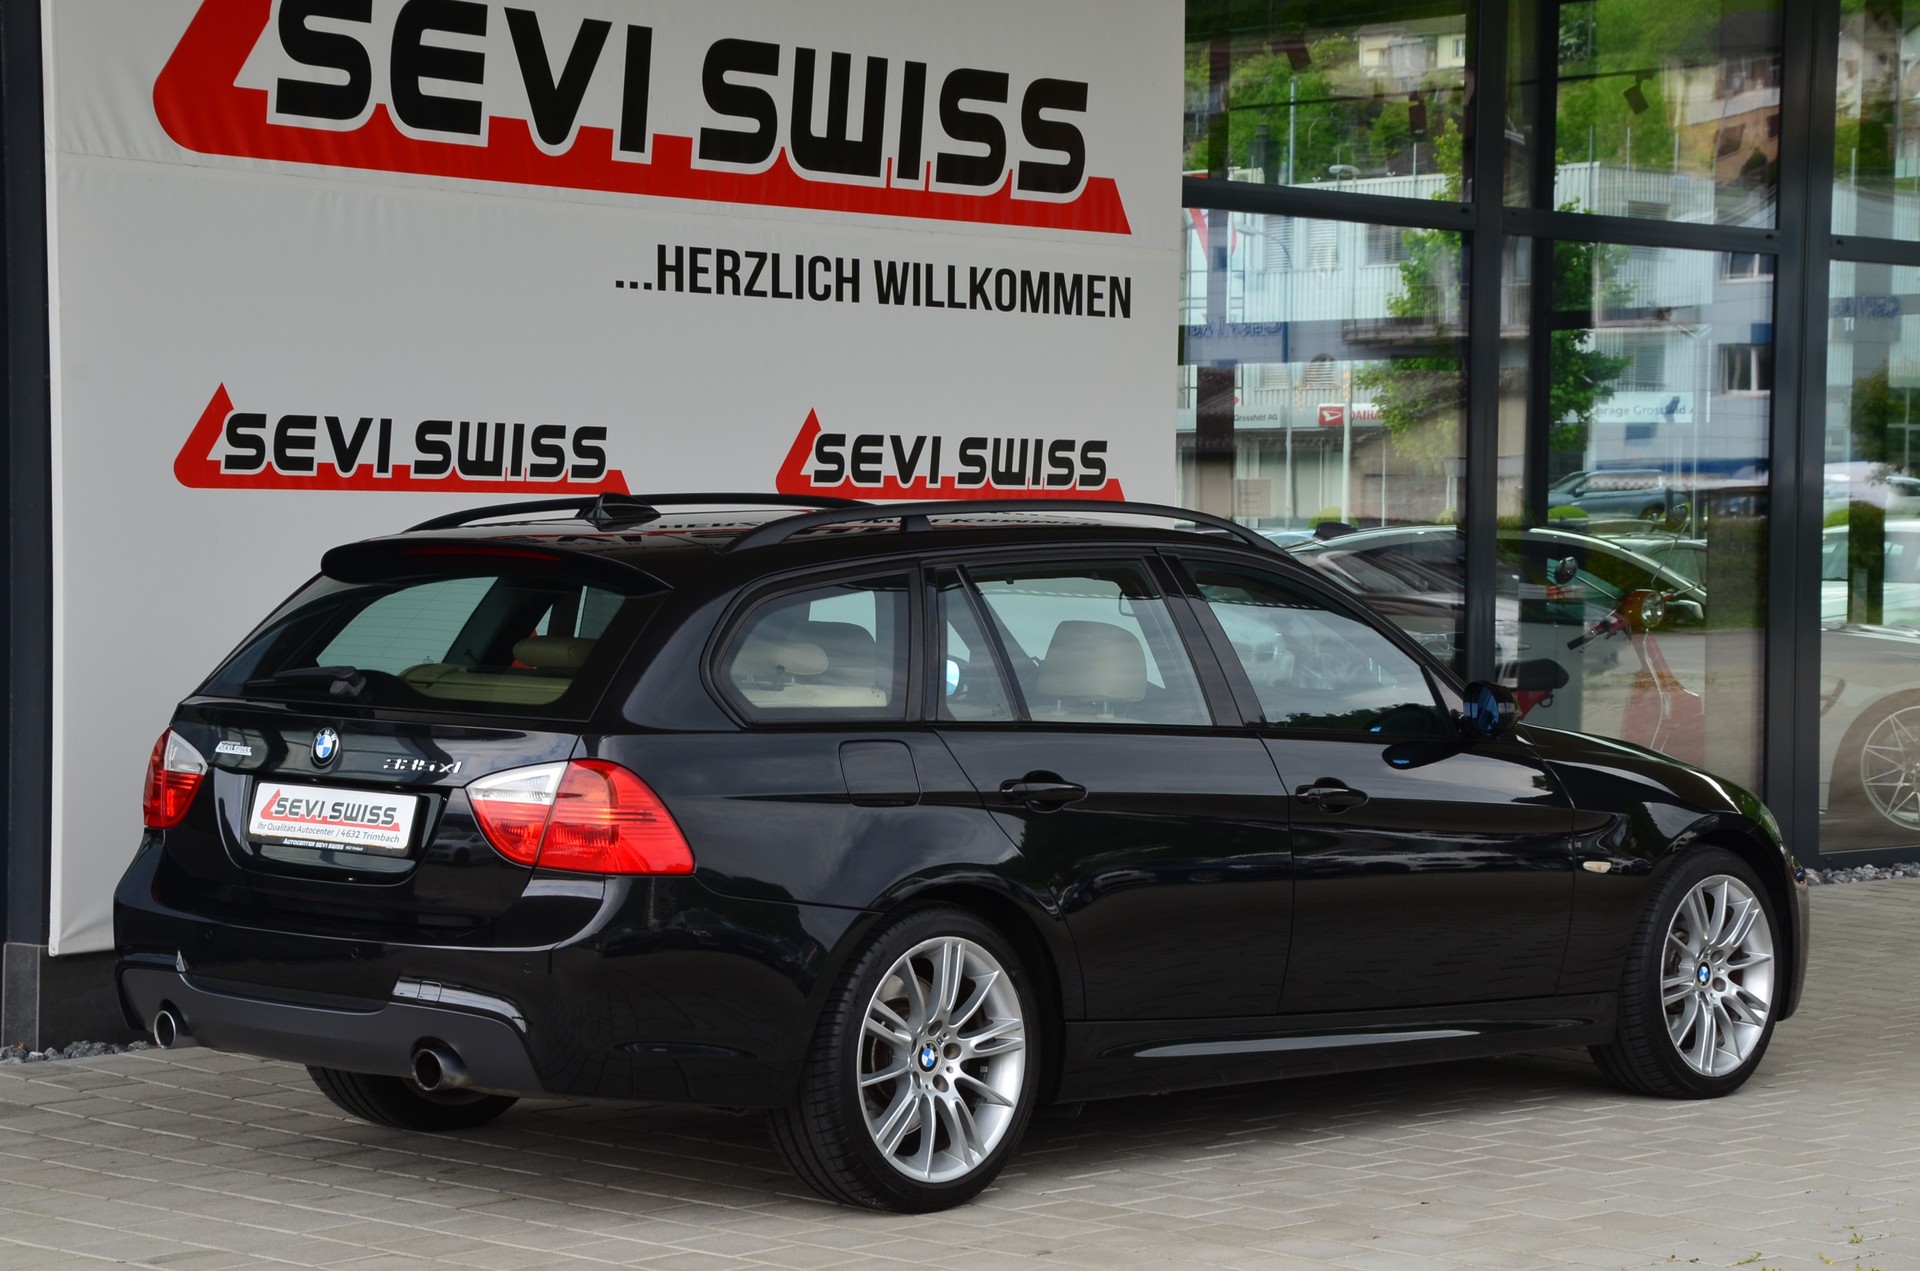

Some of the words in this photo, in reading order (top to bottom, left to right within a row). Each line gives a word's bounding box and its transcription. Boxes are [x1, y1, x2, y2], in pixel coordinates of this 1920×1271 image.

[275, 0, 653, 154] SEVI
[698, 37, 1089, 194] SWISS
[873, 259, 1132, 319] WILLKOMMEN
[224, 412, 393, 474] SEVI
[413, 419, 607, 479] SWISS
[813, 433, 942, 485] SEVI
[956, 437, 1108, 487] SWISS
[257, 821, 267, 830] Ihr
[297, 825, 334, 836] Autocenter
[341, 829, 361, 839] 4632
[363, 831, 400, 844] Trimbach
[274, 797, 326, 818] SEVI
[329, 802, 397, 826] SWISS
